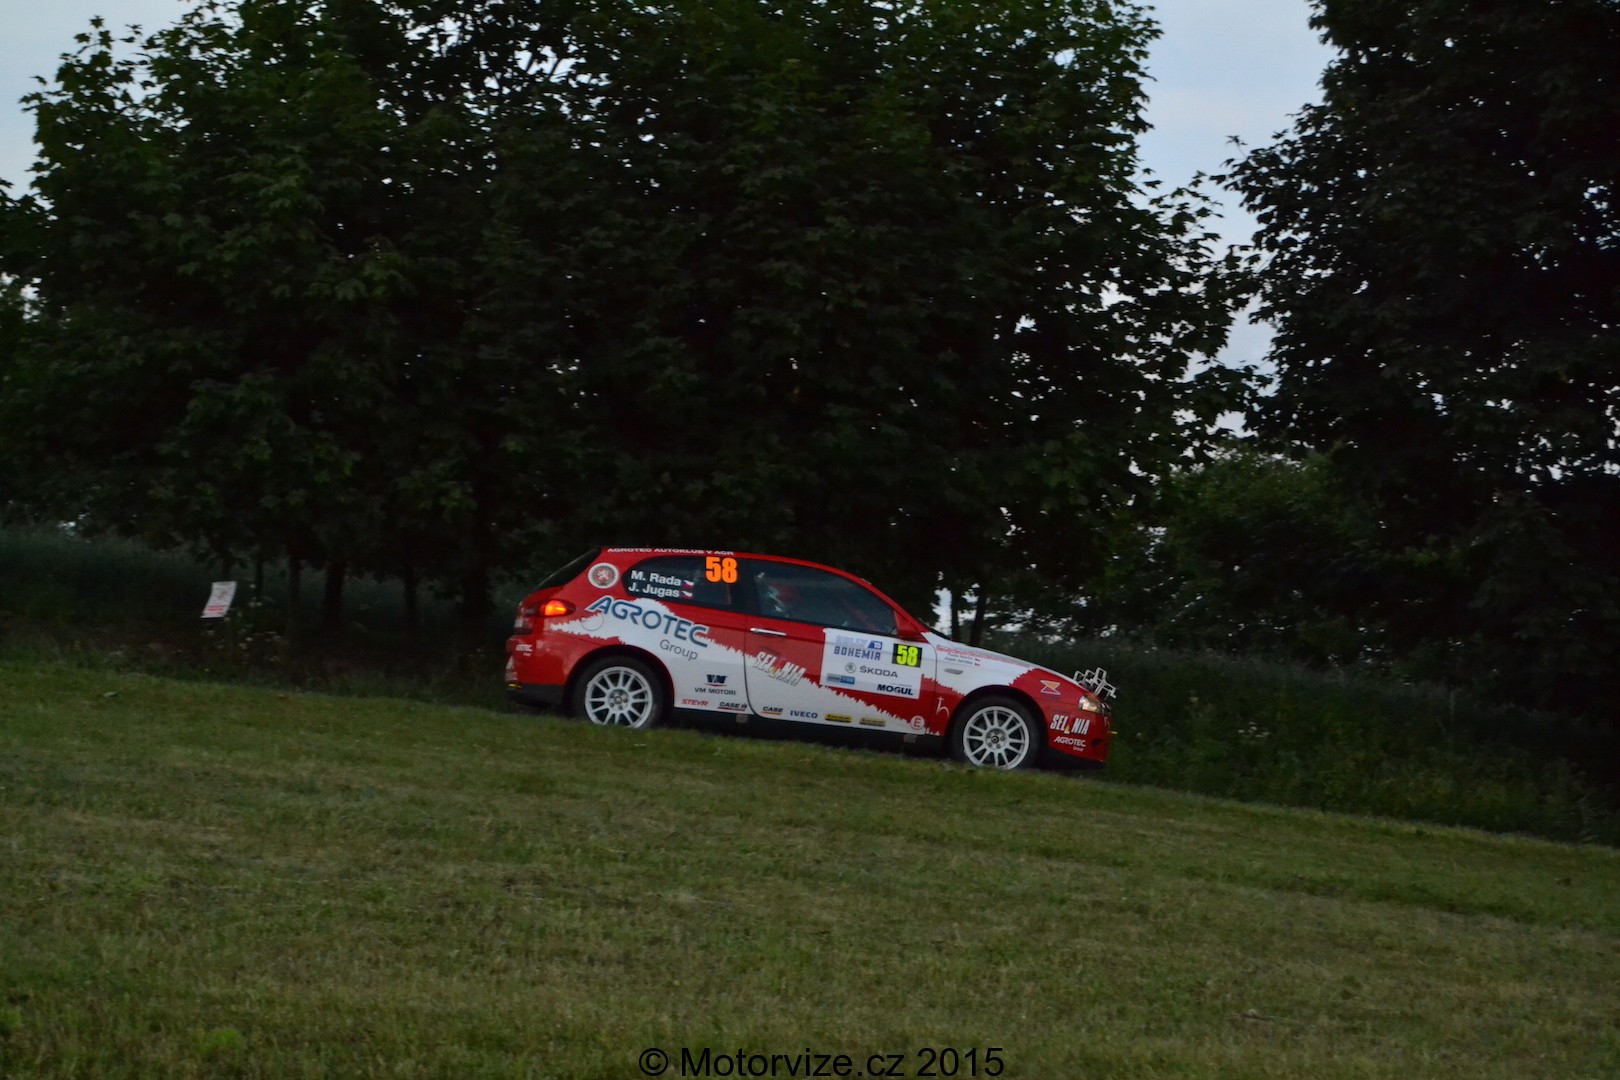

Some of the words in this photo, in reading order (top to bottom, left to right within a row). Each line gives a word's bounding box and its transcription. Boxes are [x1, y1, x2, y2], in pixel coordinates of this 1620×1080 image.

[705, 556, 738, 583] 58
[630, 569, 646, 581] M.
[649, 572, 682, 587] Rada
[627, 581, 640, 592] J.
[642, 583, 680, 598] Jugas
[588, 596, 709, 648] AGROTEC
[659, 639, 698, 661] Group
[833, 646, 882, 661] BOHEMIA
[895, 643, 919, 667] 58
[859, 665, 899, 678] ŠKODA
[708, 688, 736, 696] MOTORI
[876, 684, 914, 696] MOGUL
[681, 698, 709, 707] STEYR
[719, 701, 740, 709] CASE
[790, 710, 818, 719] IVECO
[1054, 736, 1087, 747] AGROTEC
